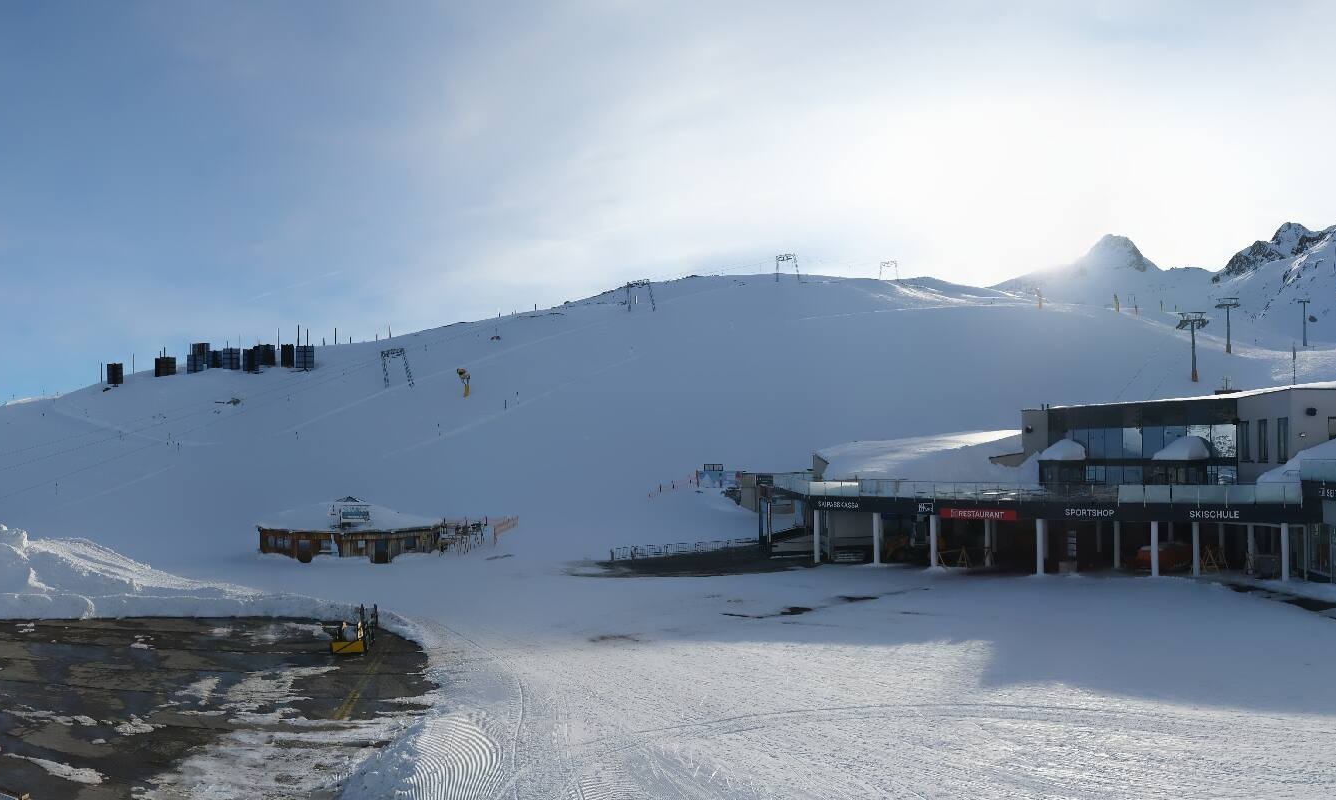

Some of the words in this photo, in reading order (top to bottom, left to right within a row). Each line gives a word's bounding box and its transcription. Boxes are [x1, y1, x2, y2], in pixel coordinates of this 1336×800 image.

[958, 510, 1005, 519] RESTAURANT
[1065, 508, 1115, 517] SPORTSHOP
[1189, 510, 1240, 519] SKISCHULE
